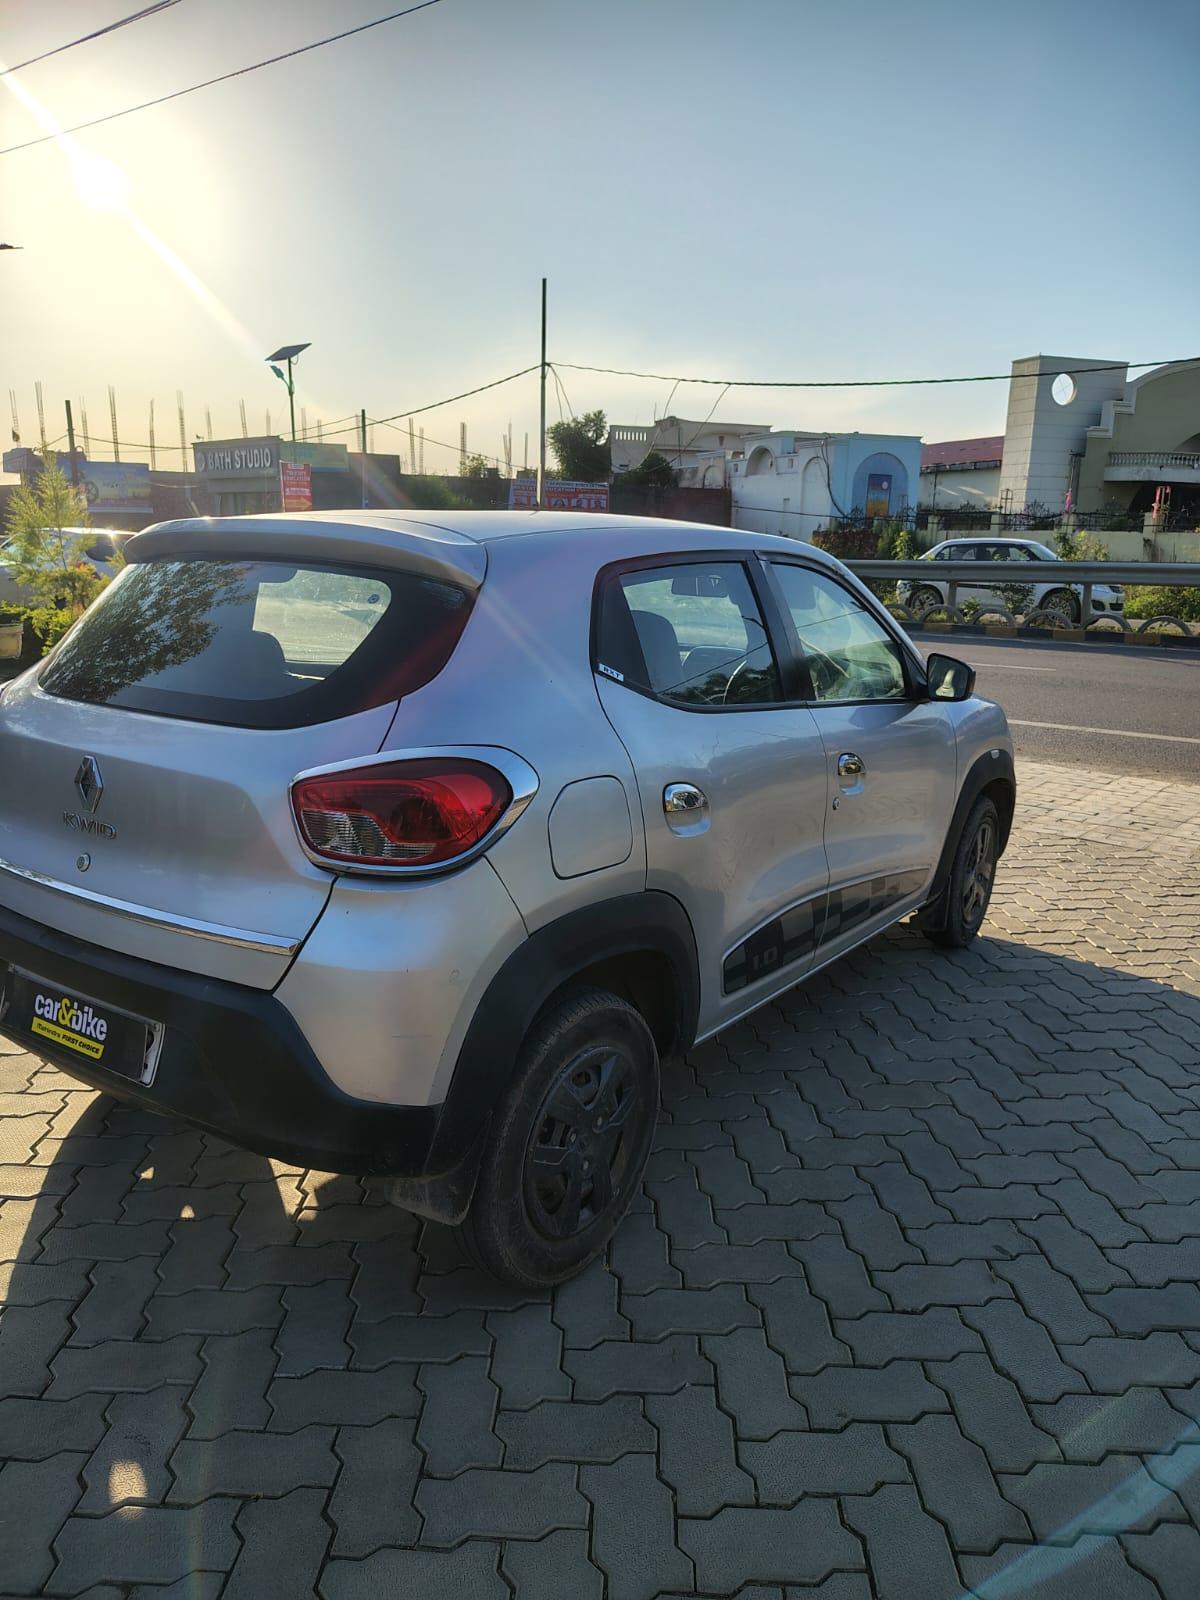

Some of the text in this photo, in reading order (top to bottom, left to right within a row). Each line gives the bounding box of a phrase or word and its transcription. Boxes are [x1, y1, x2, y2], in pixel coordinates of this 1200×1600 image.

[208, 448, 271, 470] BATH STUDIO
[64, 810, 116, 839] KWID
[35, 994, 107, 1041] car&bike
[63, 1034, 79, 1046] FIRST
[79, 1039, 101, 1055] CHOICE
